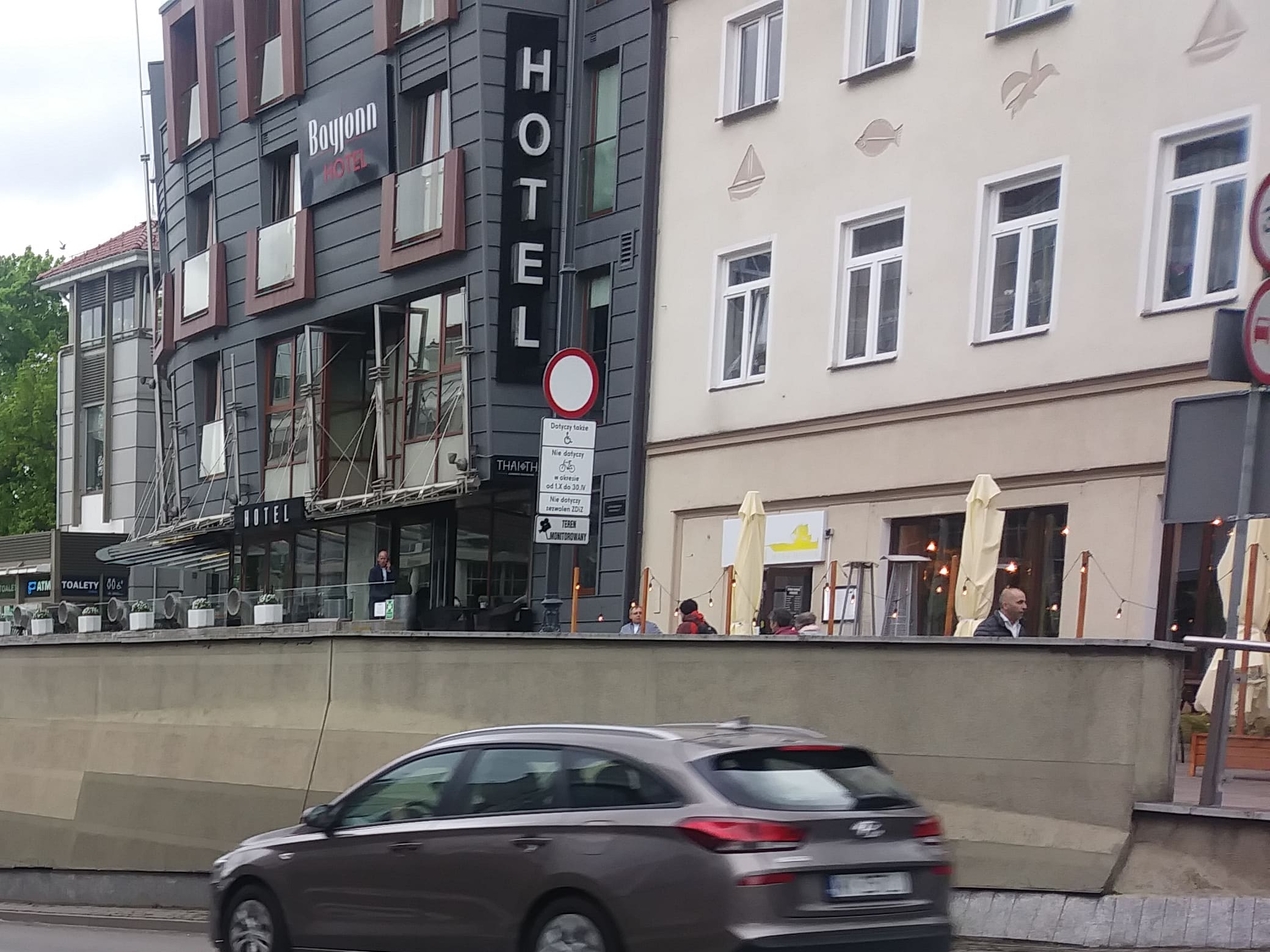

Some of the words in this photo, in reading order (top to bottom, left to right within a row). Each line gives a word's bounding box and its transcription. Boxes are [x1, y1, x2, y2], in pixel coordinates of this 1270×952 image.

[308, 102, 377, 155] Bayjonn
[323, 148, 368, 183] HOTEL
[515, 46, 552, 348] HOTEL
[550, 422, 572, 431] Dotyczy
[563, 450, 585, 459] dotyczy
[496, 459, 520, 472] THAI
[561, 496, 581, 505] dotyczy
[244, 504, 289, 527] HOTEL
[562, 519, 577, 528] TEREN
[549, 532, 587, 541] MONITOROWANY
[36, 580, 51, 592] ATM
[61, 580, 99, 590] TOALETY
